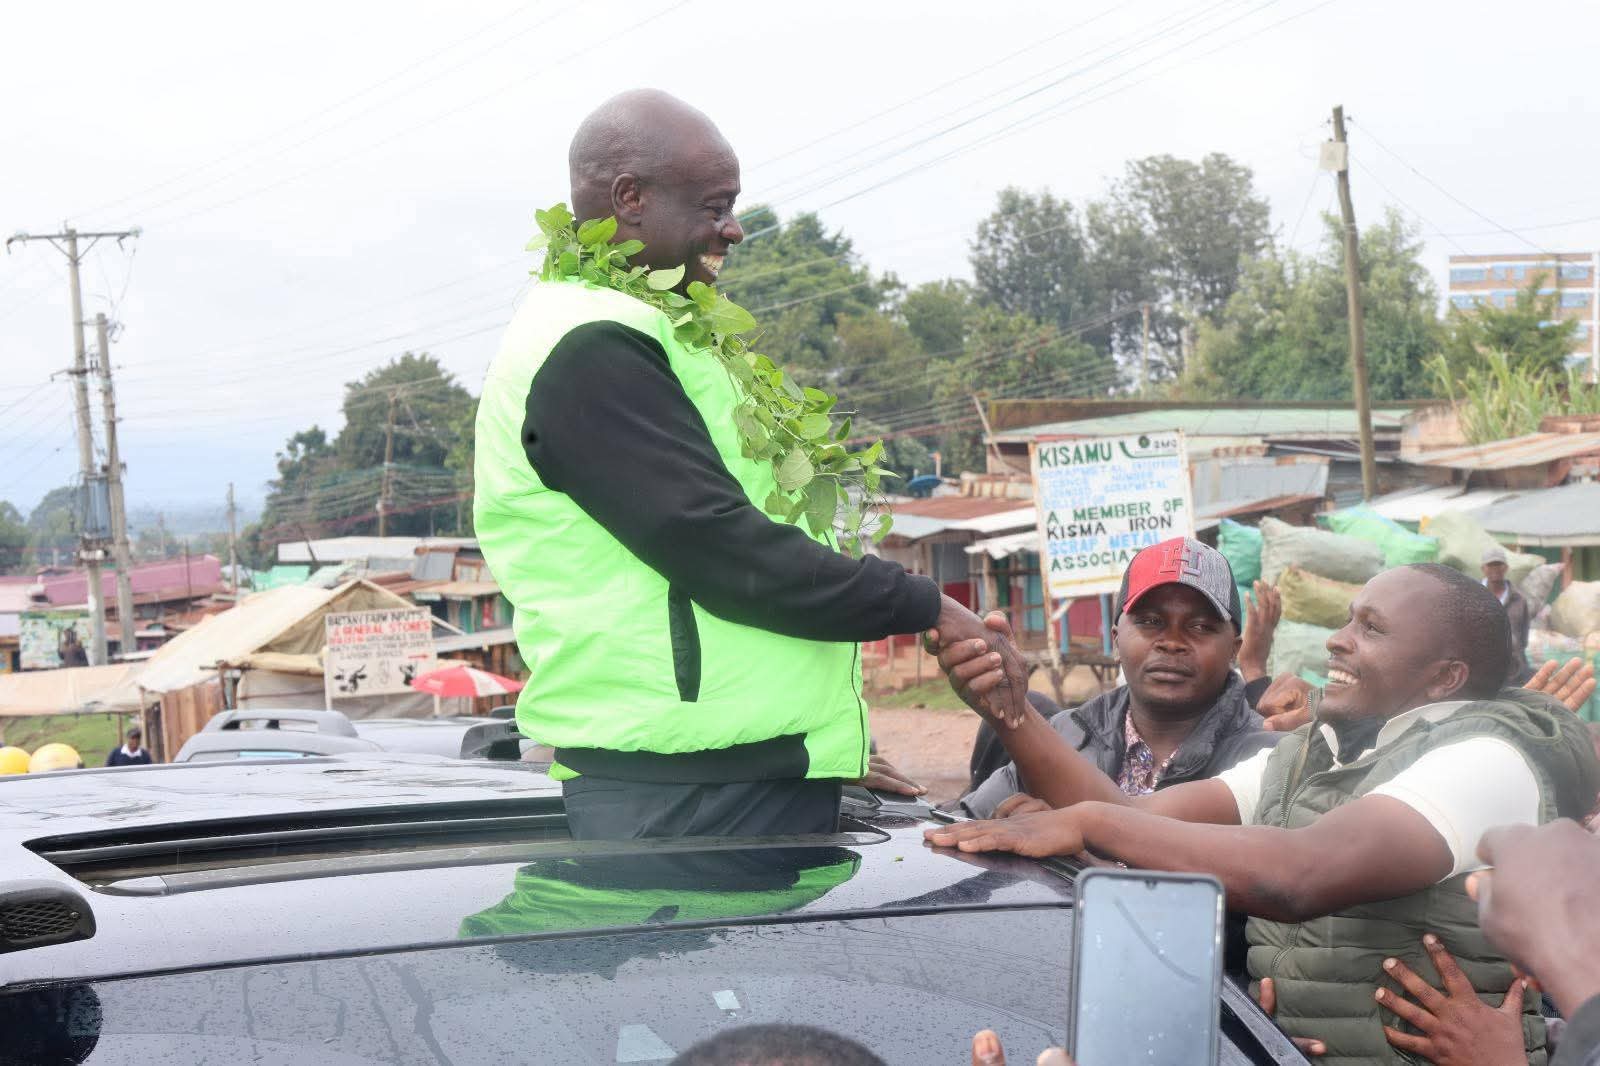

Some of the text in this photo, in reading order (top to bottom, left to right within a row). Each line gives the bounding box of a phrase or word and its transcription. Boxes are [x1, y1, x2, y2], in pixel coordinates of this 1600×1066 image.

[1039, 441, 1112, 468] KISAMU
[1047, 498, 1183, 524] A MEMBER OF
[1047, 515, 1172, 540] KISMA IRON
[1048, 531, 1160, 555] SCRAP METAL
[1051, 549, 1142, 572] ASSOCIA
